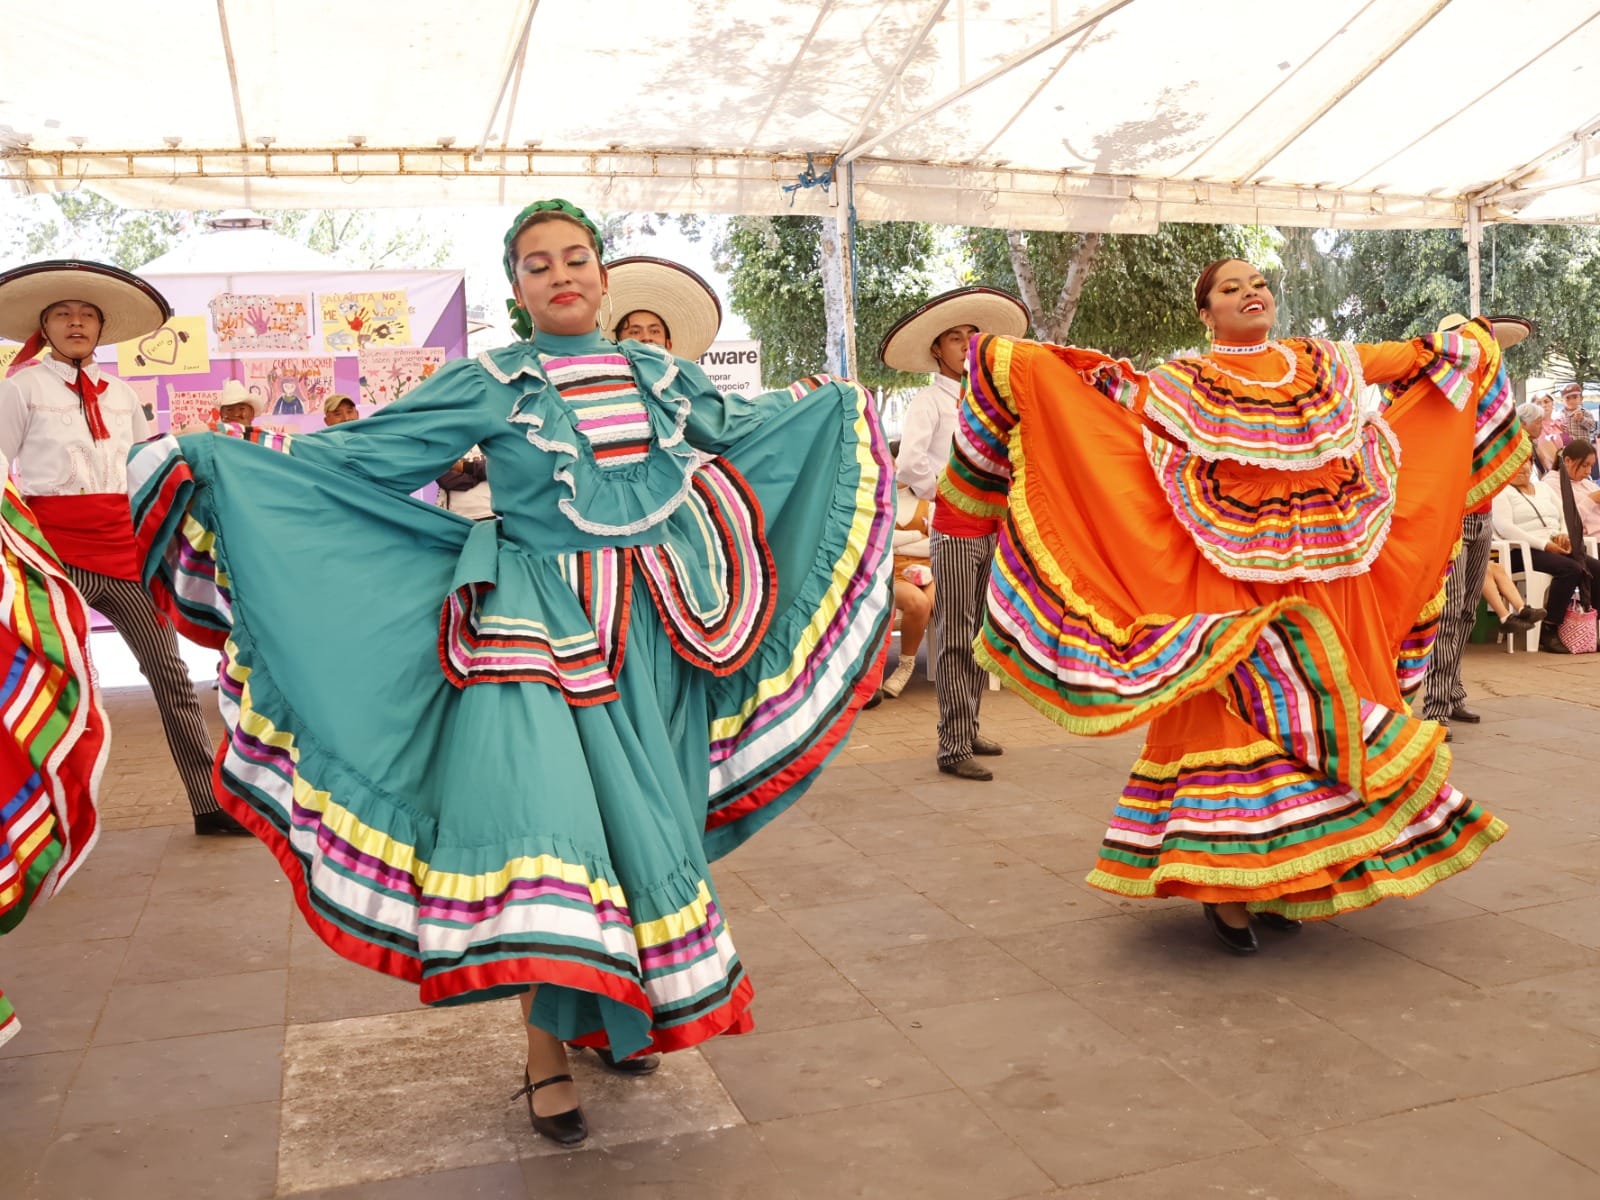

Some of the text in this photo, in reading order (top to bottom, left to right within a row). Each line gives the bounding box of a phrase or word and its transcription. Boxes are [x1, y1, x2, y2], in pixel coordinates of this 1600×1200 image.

[382, 292, 396, 300] NO
[323, 310, 336, 320] ME
[696, 350, 758, 365] rware
[715, 382, 750, 392] egocio?
